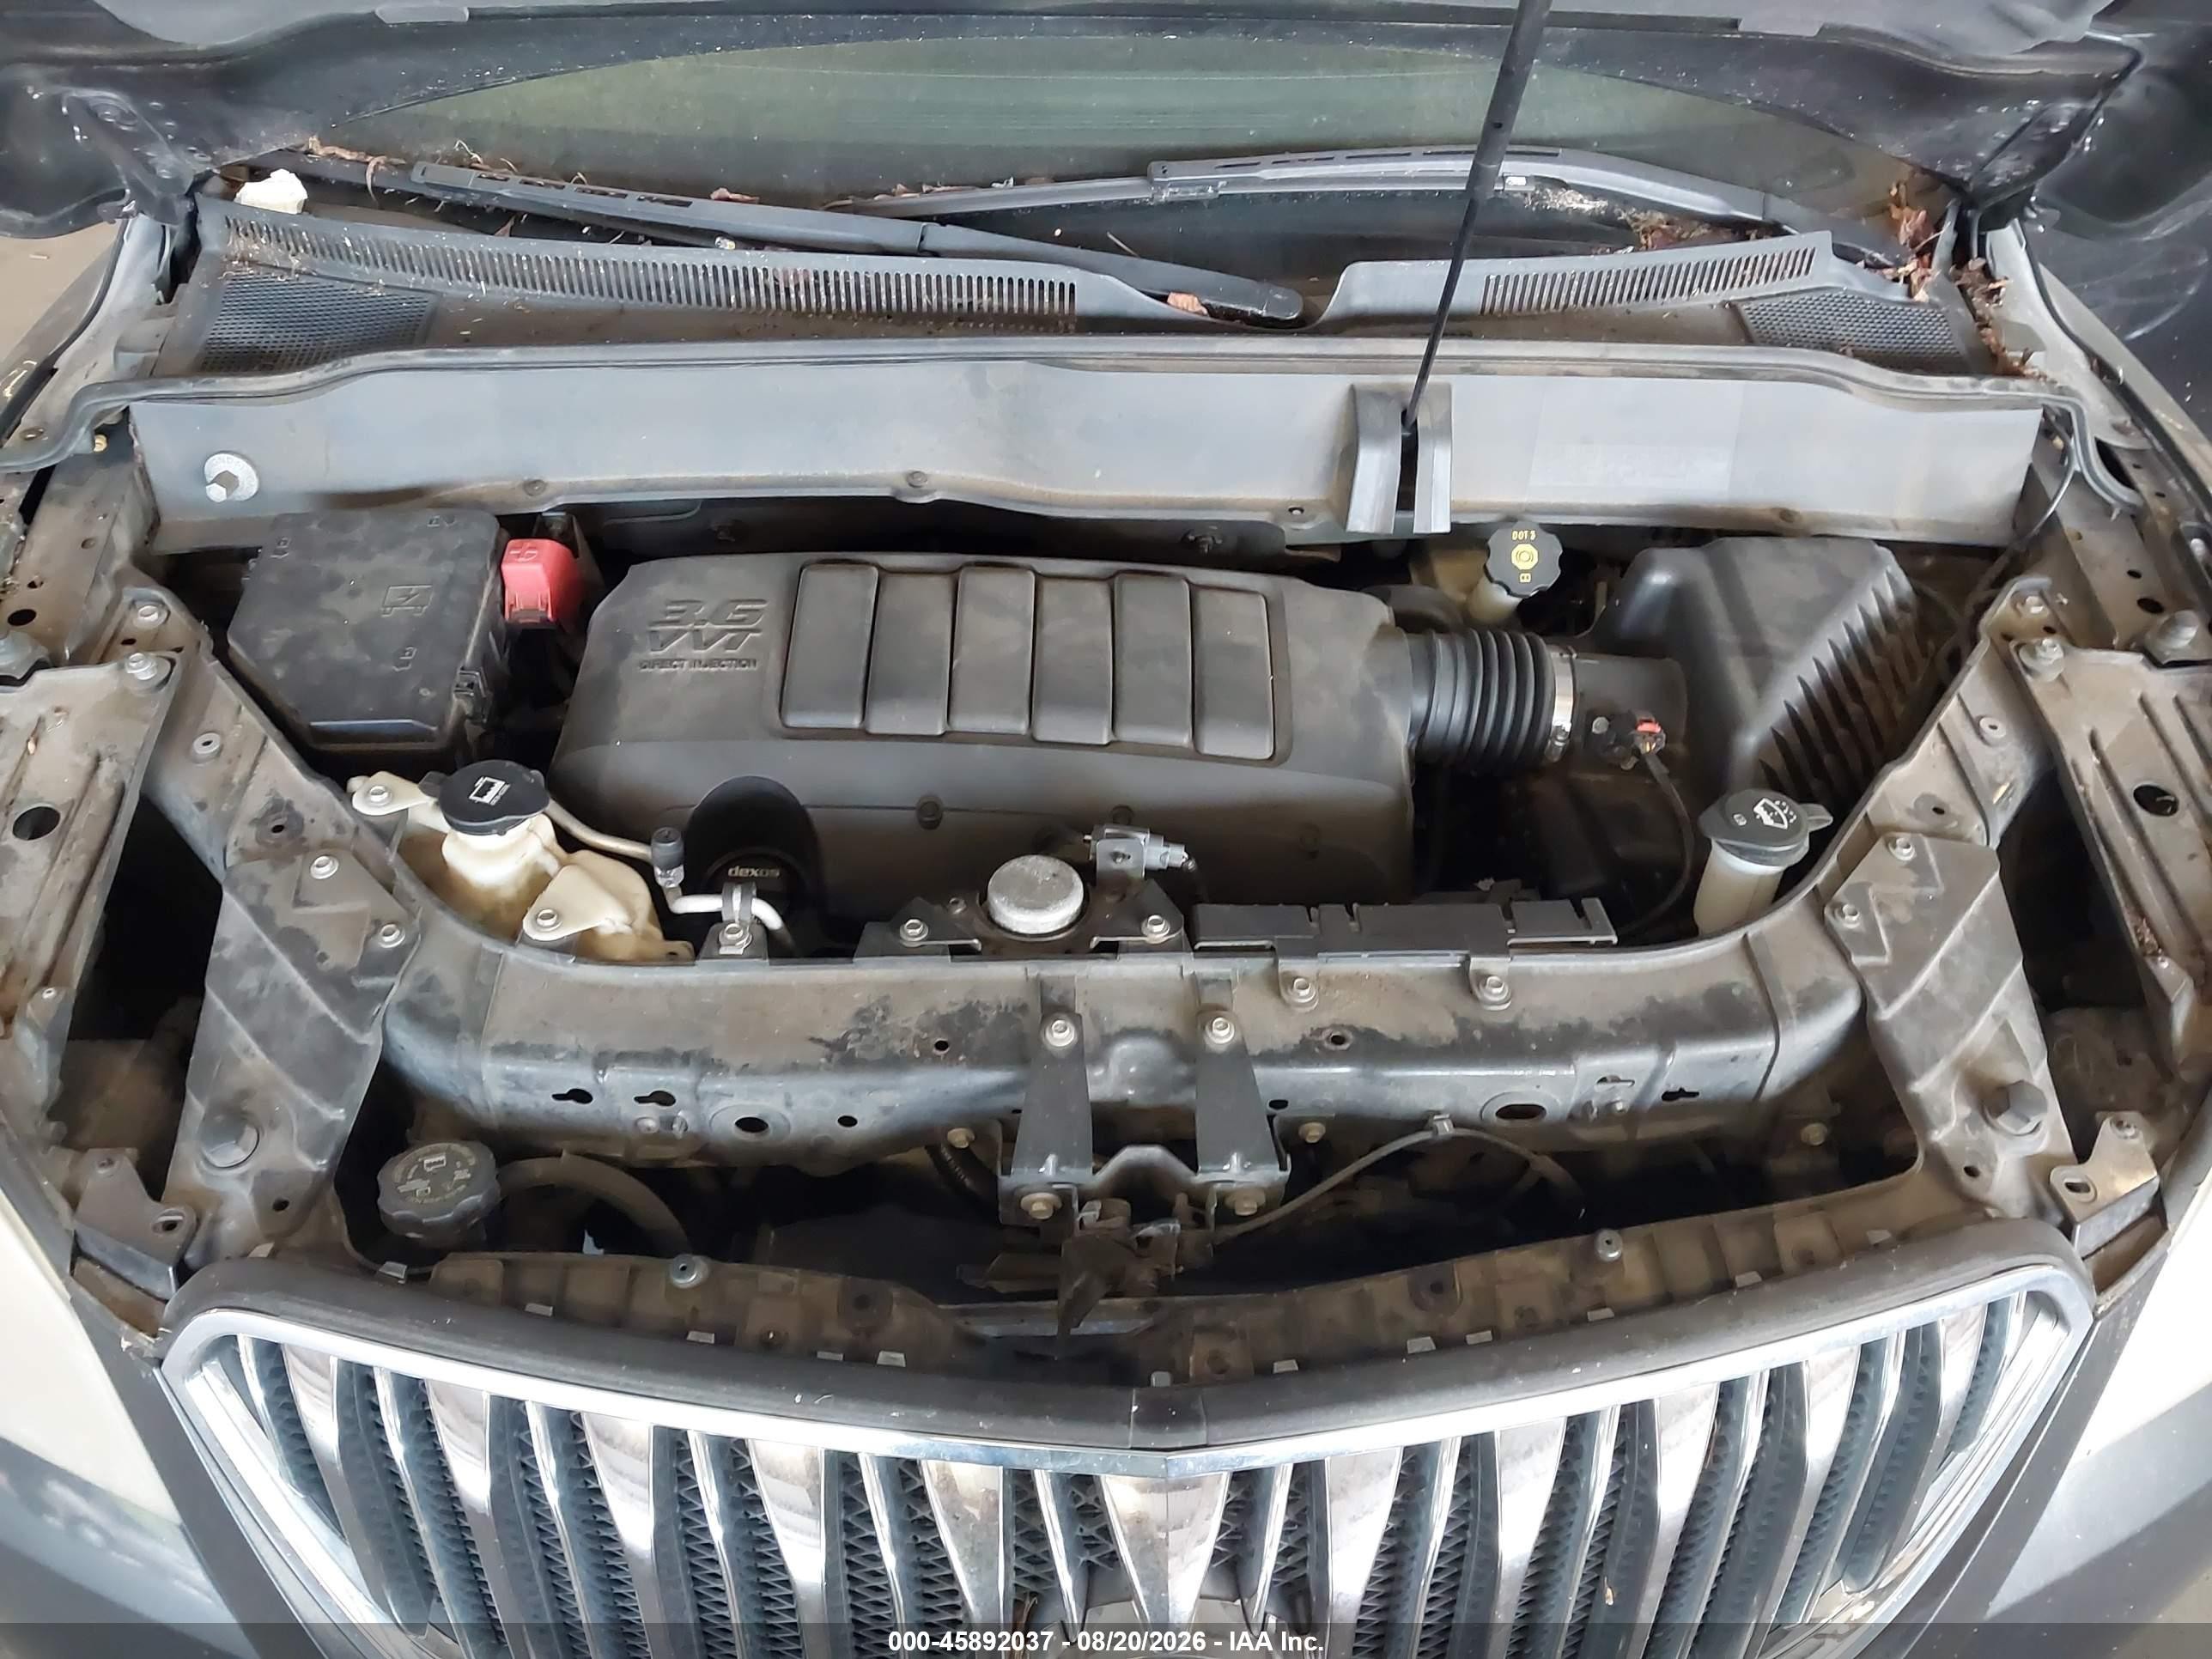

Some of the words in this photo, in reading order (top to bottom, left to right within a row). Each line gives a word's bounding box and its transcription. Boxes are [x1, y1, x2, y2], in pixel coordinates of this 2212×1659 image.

[1511, 530, 1528, 541] DOT
[648, 599, 768, 629] 3.6
[647, 627, 763, 653] VVT
[639, 658, 687, 672] DIRECT
[688, 658, 757, 672] INJECTION
[727, 865, 781, 878] dexos
